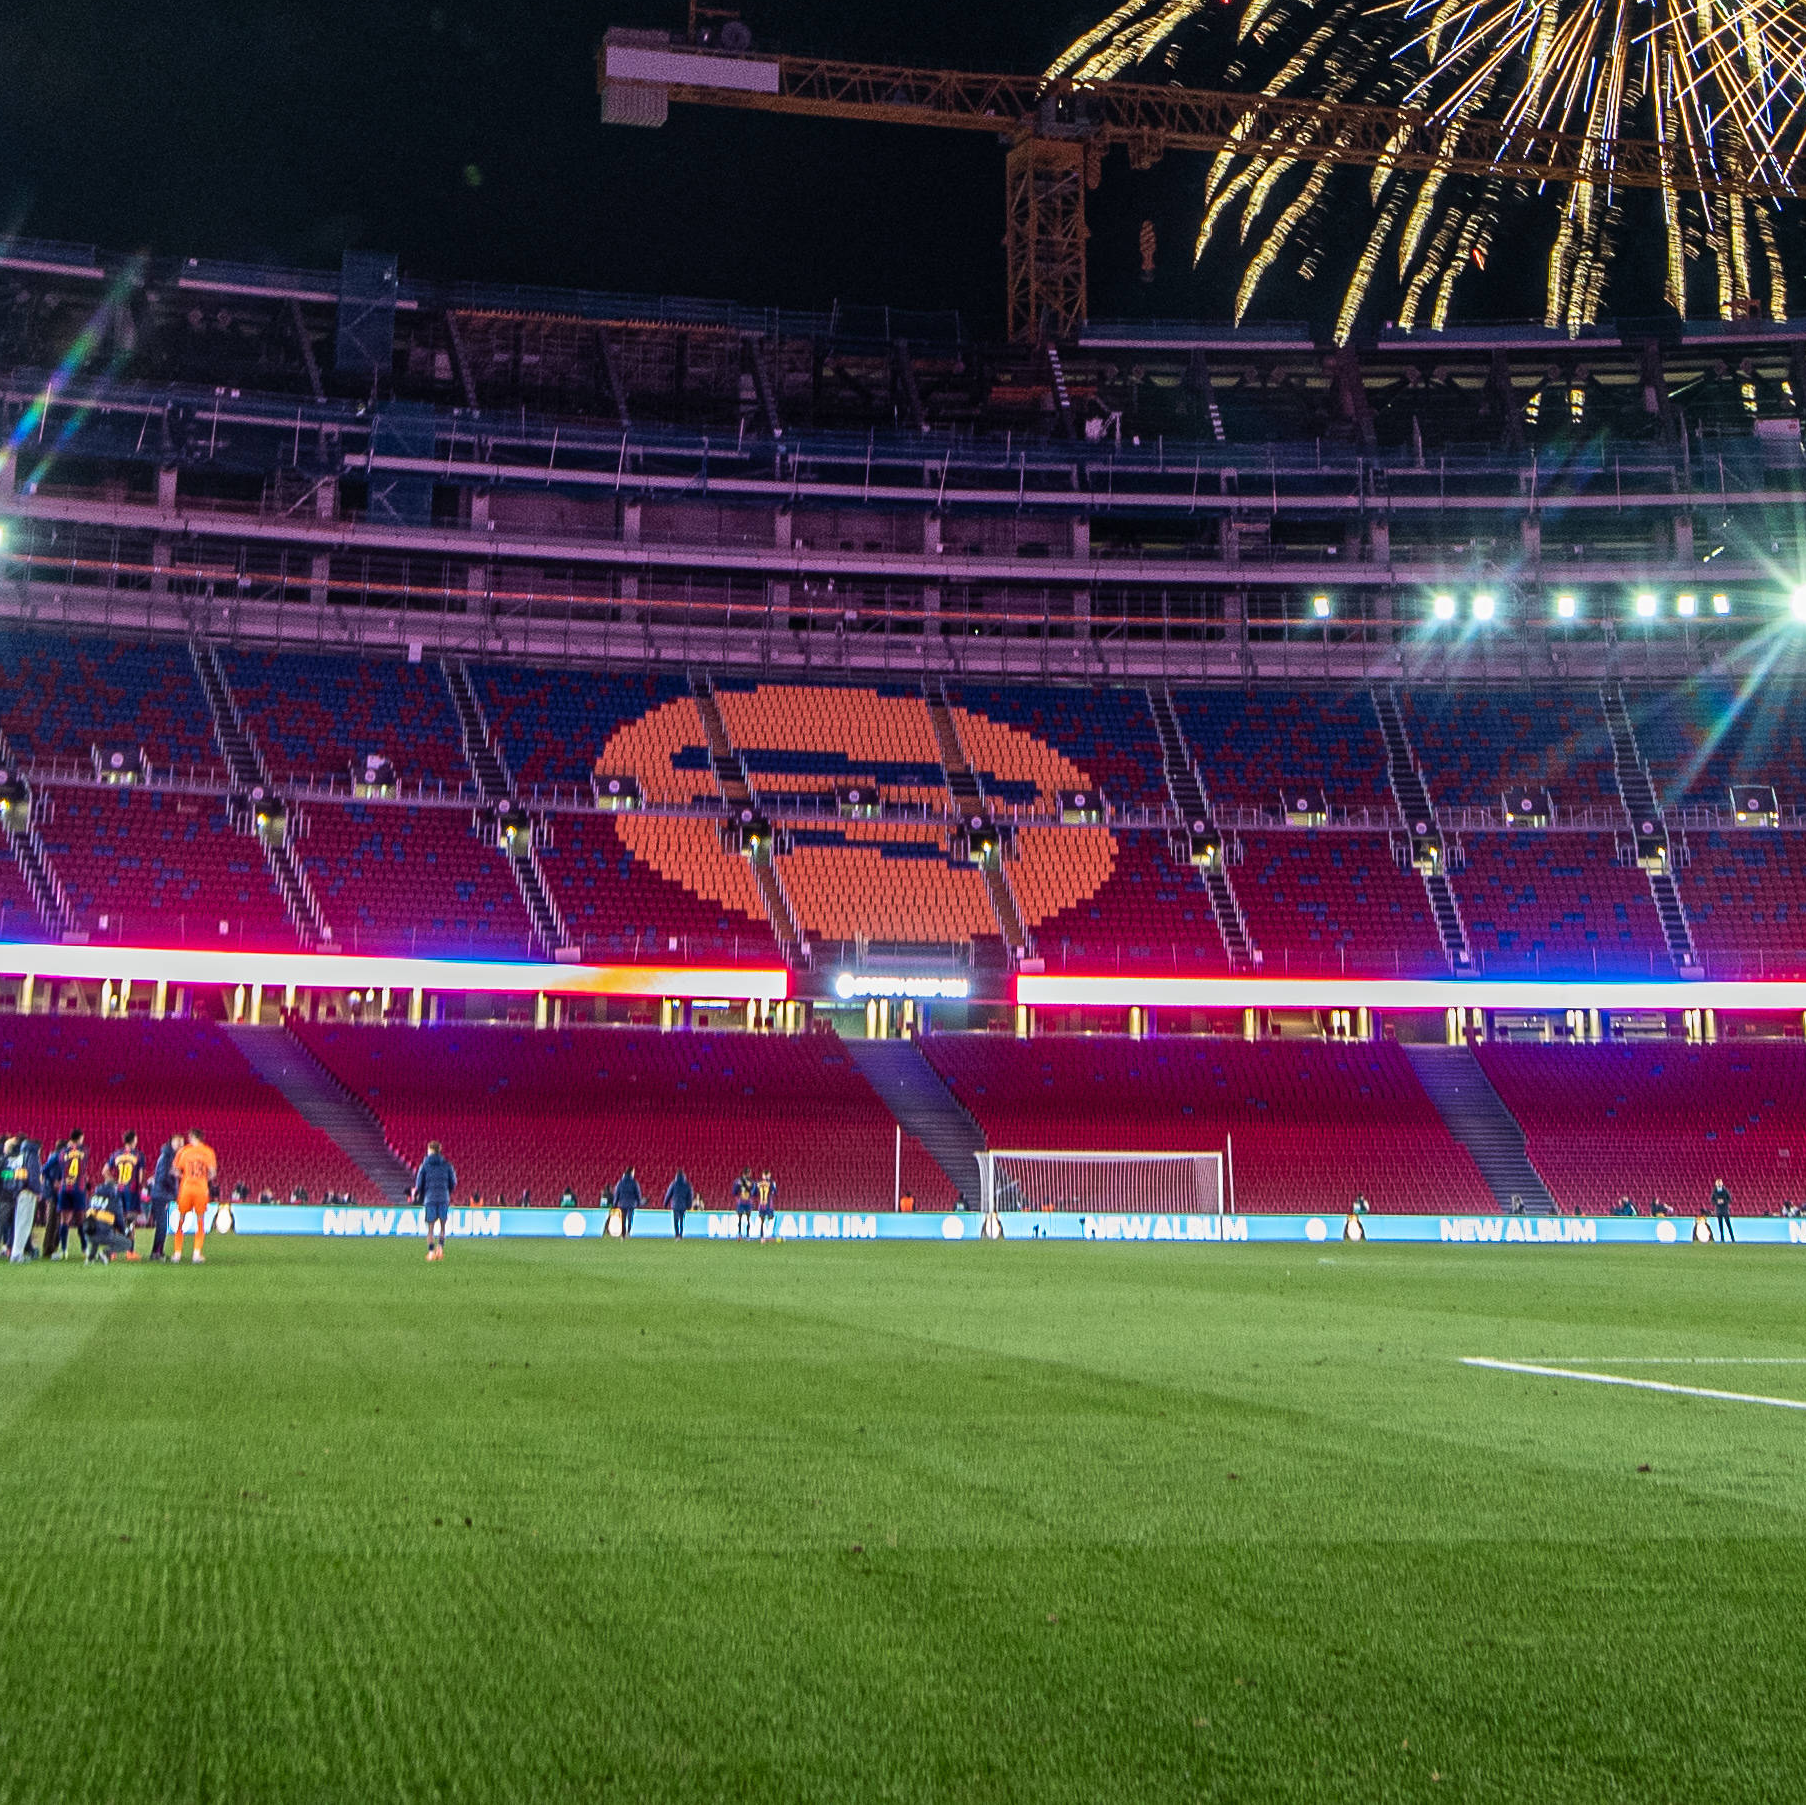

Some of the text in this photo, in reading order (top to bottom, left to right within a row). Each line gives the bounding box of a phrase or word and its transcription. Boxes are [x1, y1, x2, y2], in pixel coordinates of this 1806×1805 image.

[322, 1209, 395, 1236] NEW
[707, 1215, 877, 1238] NEW ALBUM
[1084, 1216, 1248, 1241] NEW ALBUM
[1440, 1218, 1597, 1243] NEW ALBUM
